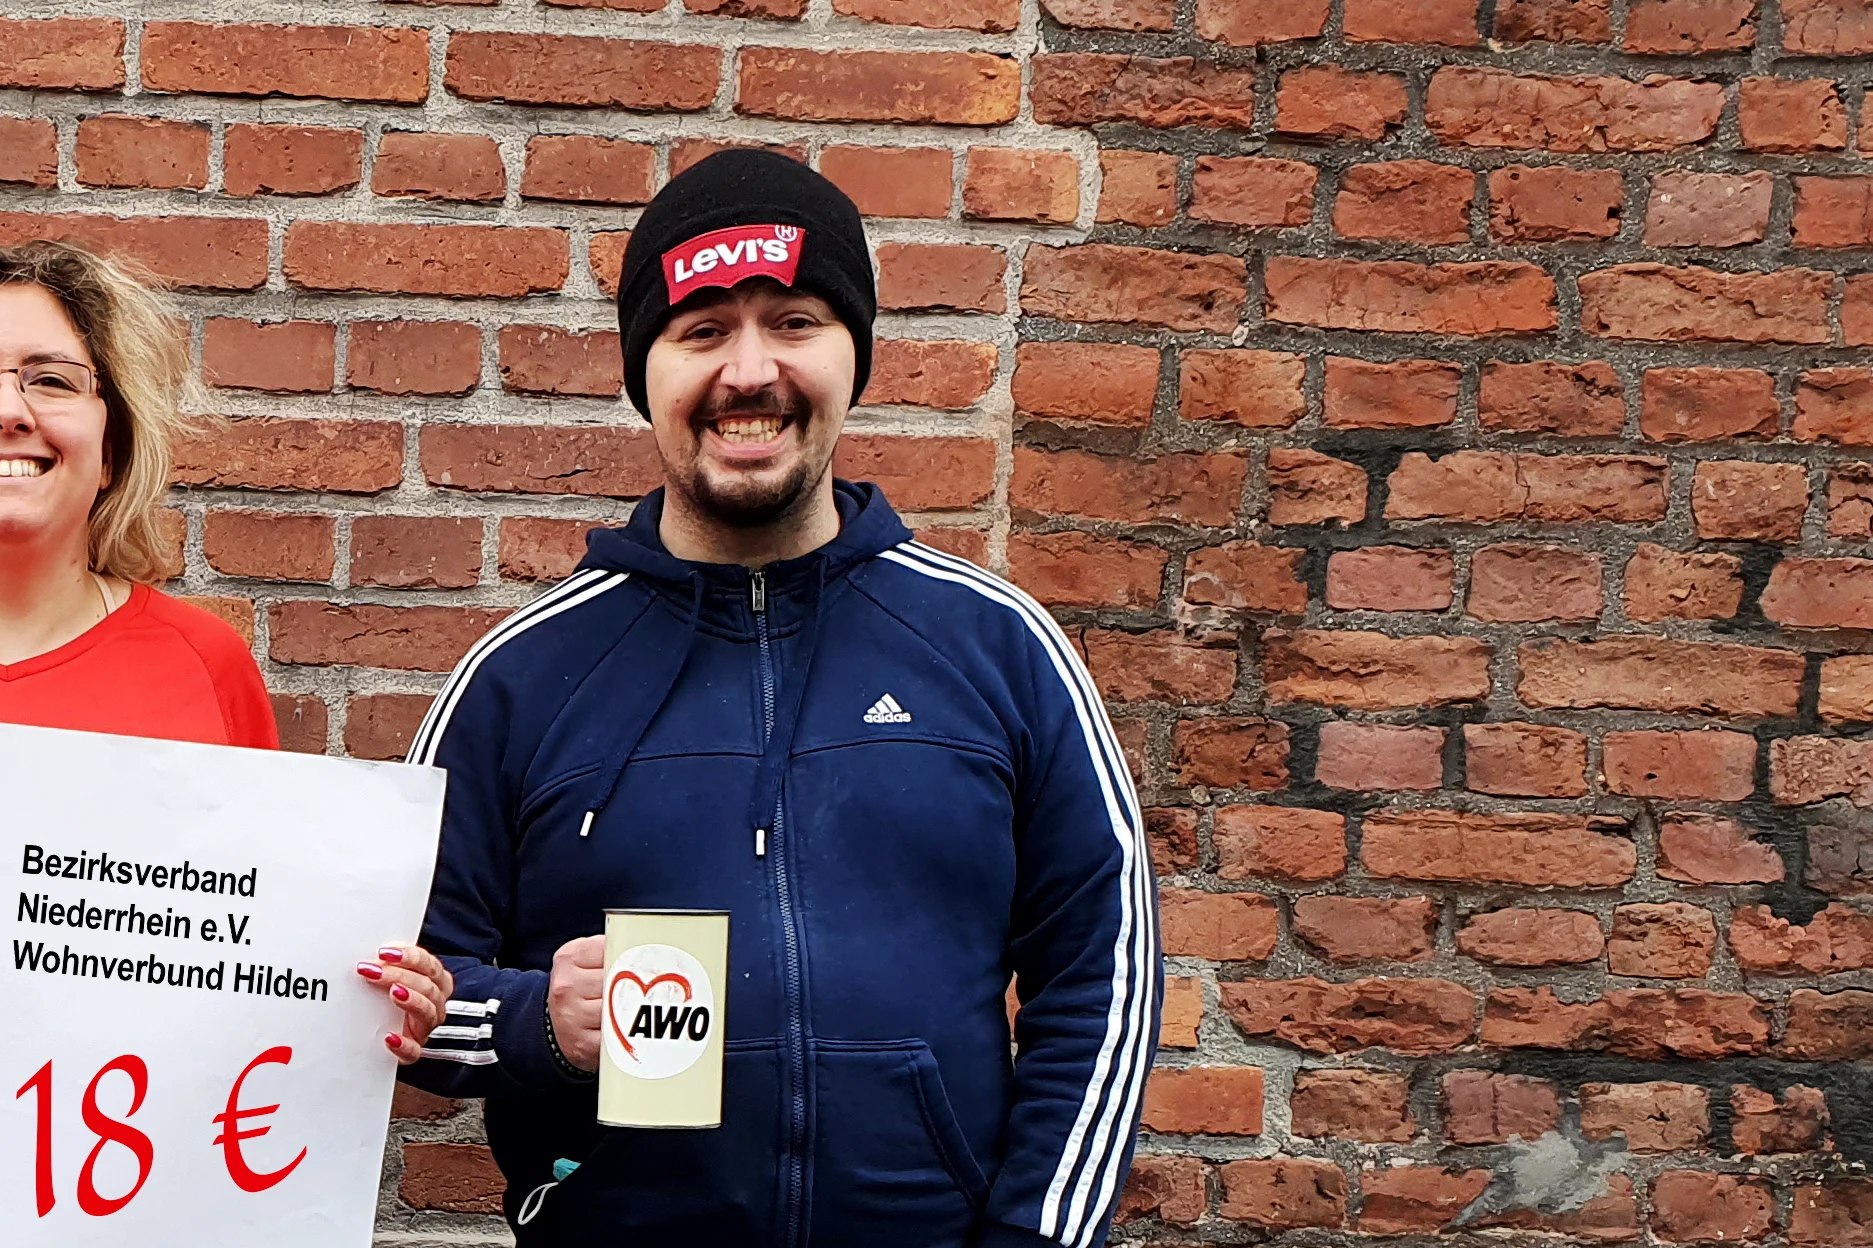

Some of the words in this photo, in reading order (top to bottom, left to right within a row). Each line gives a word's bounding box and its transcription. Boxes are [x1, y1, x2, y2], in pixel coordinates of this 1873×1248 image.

[863, 712, 911, 723] adidas
[22, 844, 257, 898] Bezirksverband
[17, 892, 191, 940] Niederrhein
[200, 914, 252, 946] e.V.
[12, 939, 225, 991] Wohnverbund
[233, 962, 329, 1002] Hilden
[628, 1004, 710, 1042] AWO
[211, 1045, 308, 1193] €
